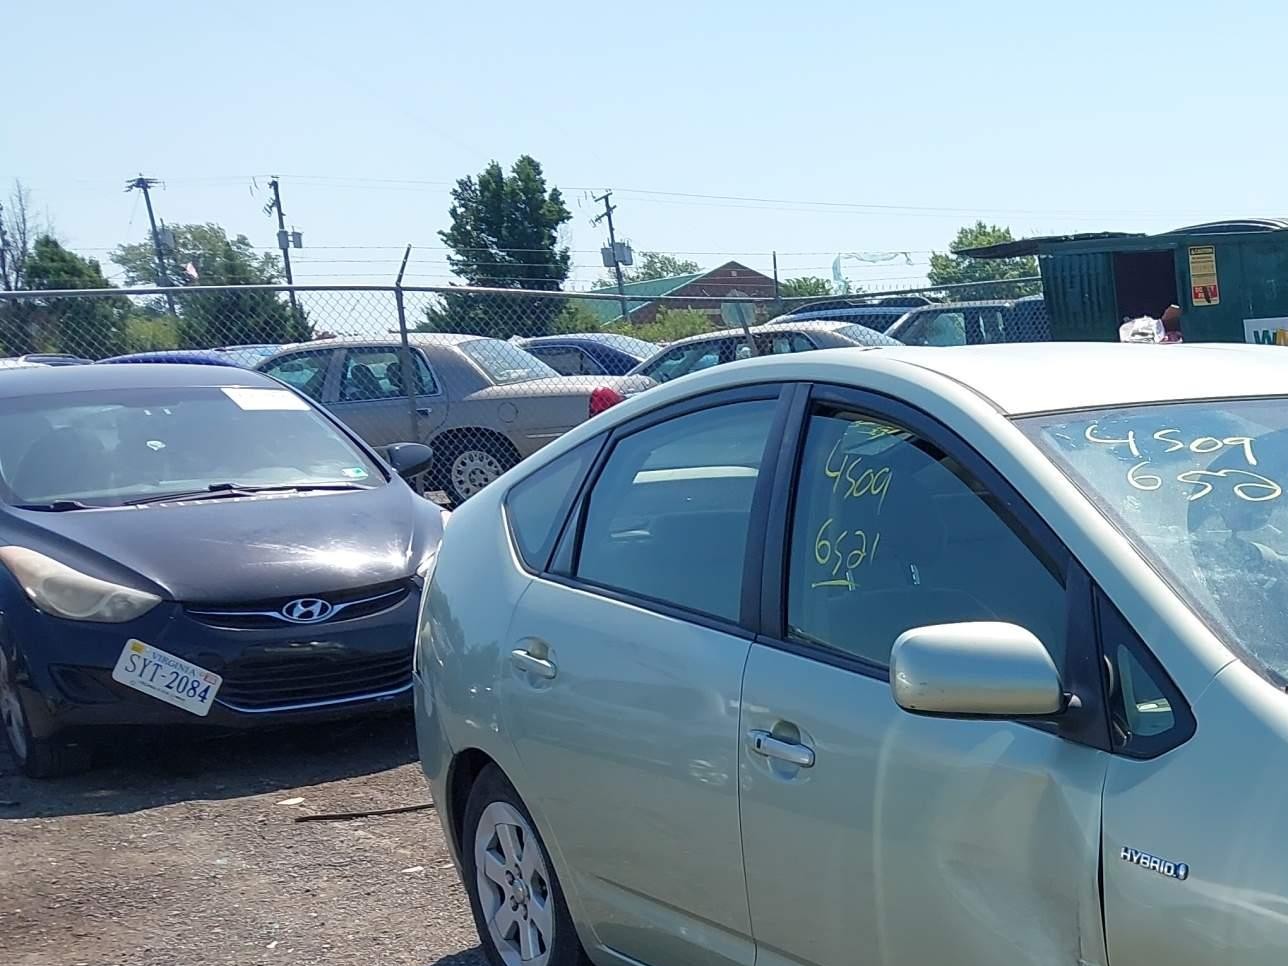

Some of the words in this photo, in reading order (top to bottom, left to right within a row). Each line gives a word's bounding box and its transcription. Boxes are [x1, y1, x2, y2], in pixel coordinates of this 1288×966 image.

[1085, 423, 1257, 466] 4509
[825, 439, 893, 515] 4509
[815, 518, 881, 577] 6521
[125, 653, 211, 704] SYT-2084
[152, 651, 196, 678] VIRGINIA
[1120, 847, 1175, 877] HYBRID
